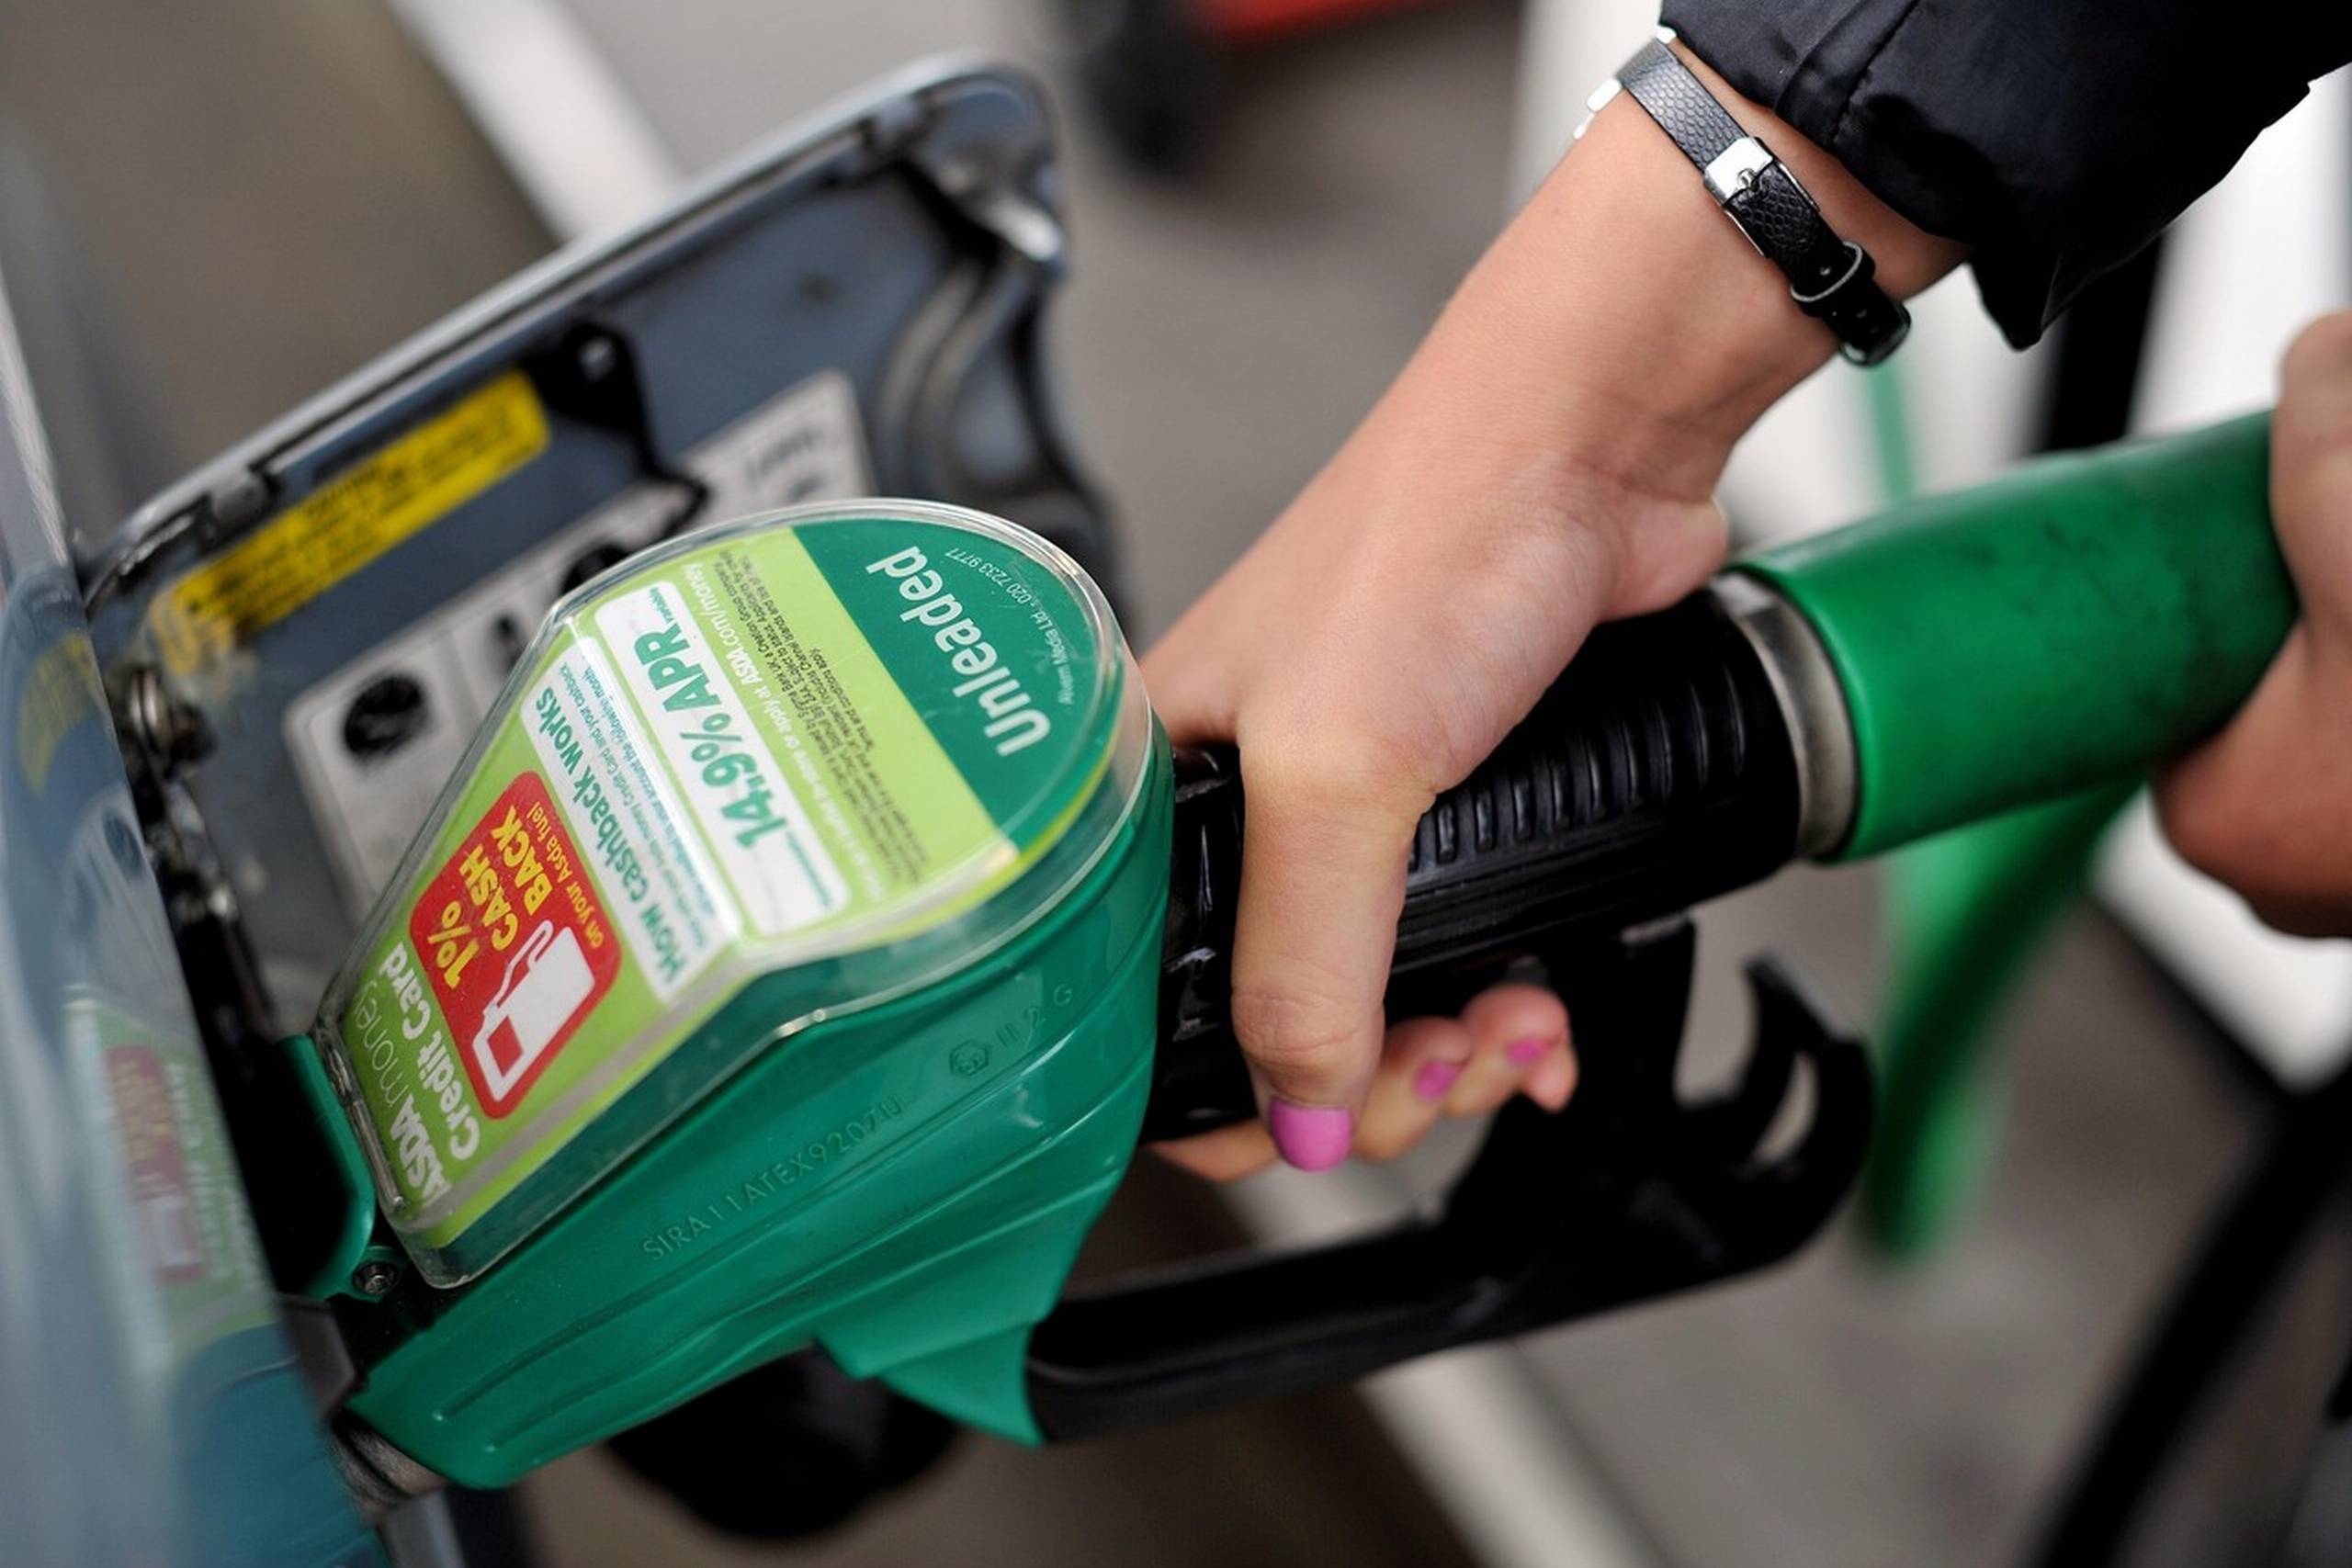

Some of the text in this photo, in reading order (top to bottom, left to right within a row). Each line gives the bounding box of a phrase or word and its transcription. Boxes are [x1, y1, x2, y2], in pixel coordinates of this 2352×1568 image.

[944, 546, 981, 567] 9777
[978, 560, 1012, 585] 7233
[1005, 581, 1032, 604] 020
[631, 622, 720, 711] APR
[752, 684, 771, 703] at
[865, 545, 1049, 758] Unleaded
[534, 686, 582, 774] works
[761, 698, 793, 734] apply
[678, 711, 788, 851] 14.9%
[491, 804, 553, 915] BACK
[526, 800, 605, 949] on your Asda fuel
[574, 764, 647, 903] cashback
[458, 843, 519, 950] CASH
[425, 901, 481, 989] 1%
[639, 902, 686, 983] How
[351, 982, 450, 1207] ASDA money
[378, 942, 481, 1159] Credit Card
